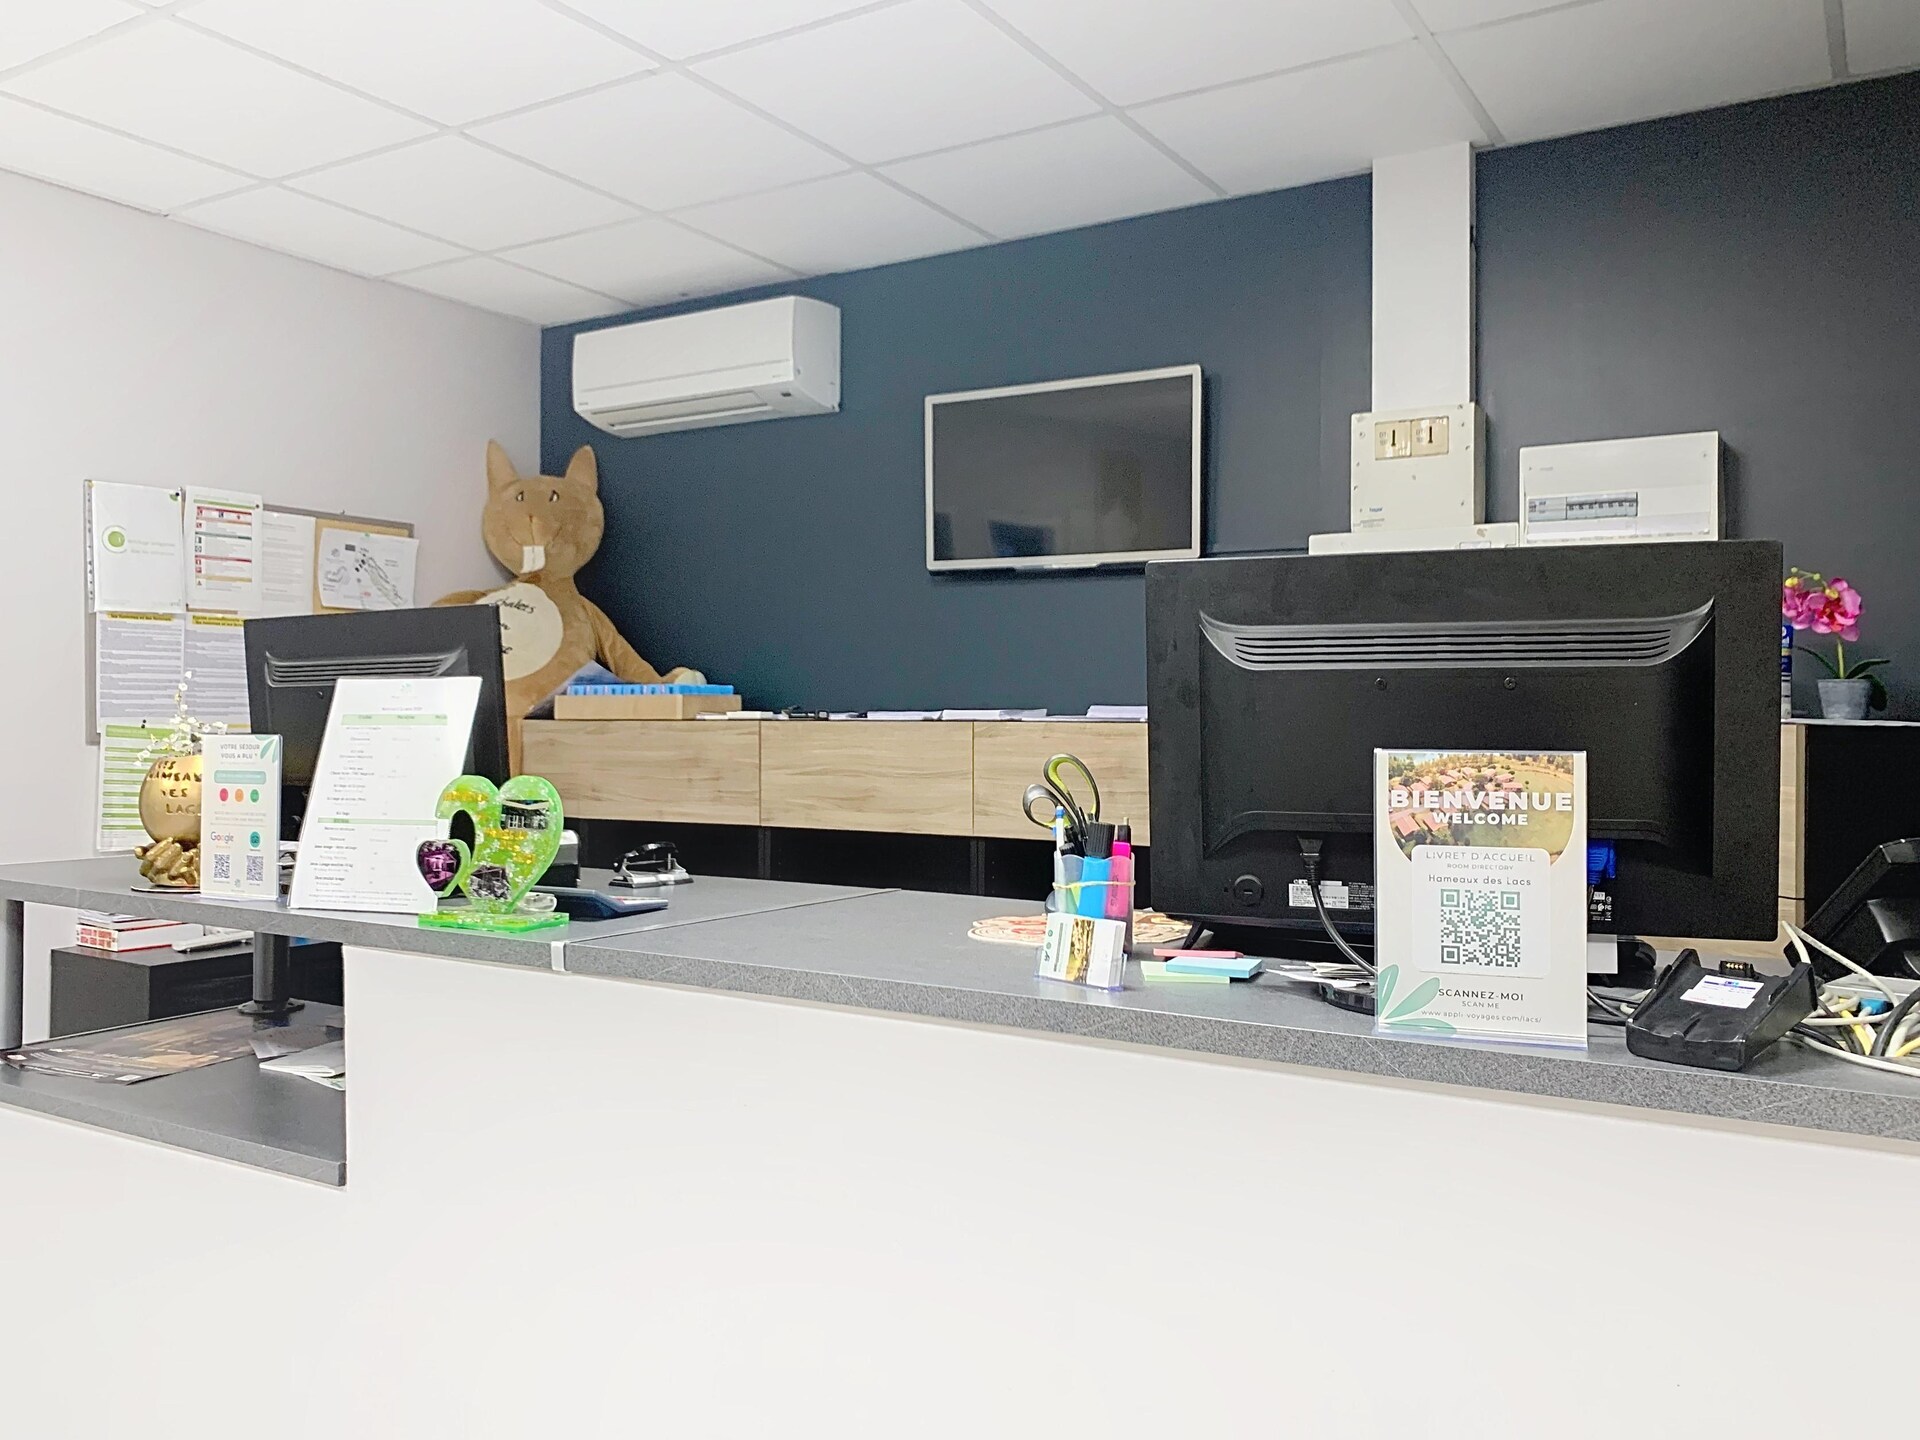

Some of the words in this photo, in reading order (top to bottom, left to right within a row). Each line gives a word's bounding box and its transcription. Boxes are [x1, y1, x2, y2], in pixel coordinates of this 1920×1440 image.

[1390, 789, 1573, 812] BIENVENUE
[1432, 811, 1529, 826] WELCOME
[210, 831, 235, 845] Google
[1425, 851, 1467, 860] LIVRET
[1446, 862, 1470, 870] ROOM
[1471, 863, 1514, 871] DIRECTORY
[1428, 873, 1479, 884] Hameaux
[1482, 875, 1503, 885] des
[1506, 876, 1532, 886] Lacs
[1438, 988, 1524, 1001] SCANNEZ-MOI
[1461, 1000, 1485, 1008] SCAN
[1487, 1002, 1500, 1010] ME
